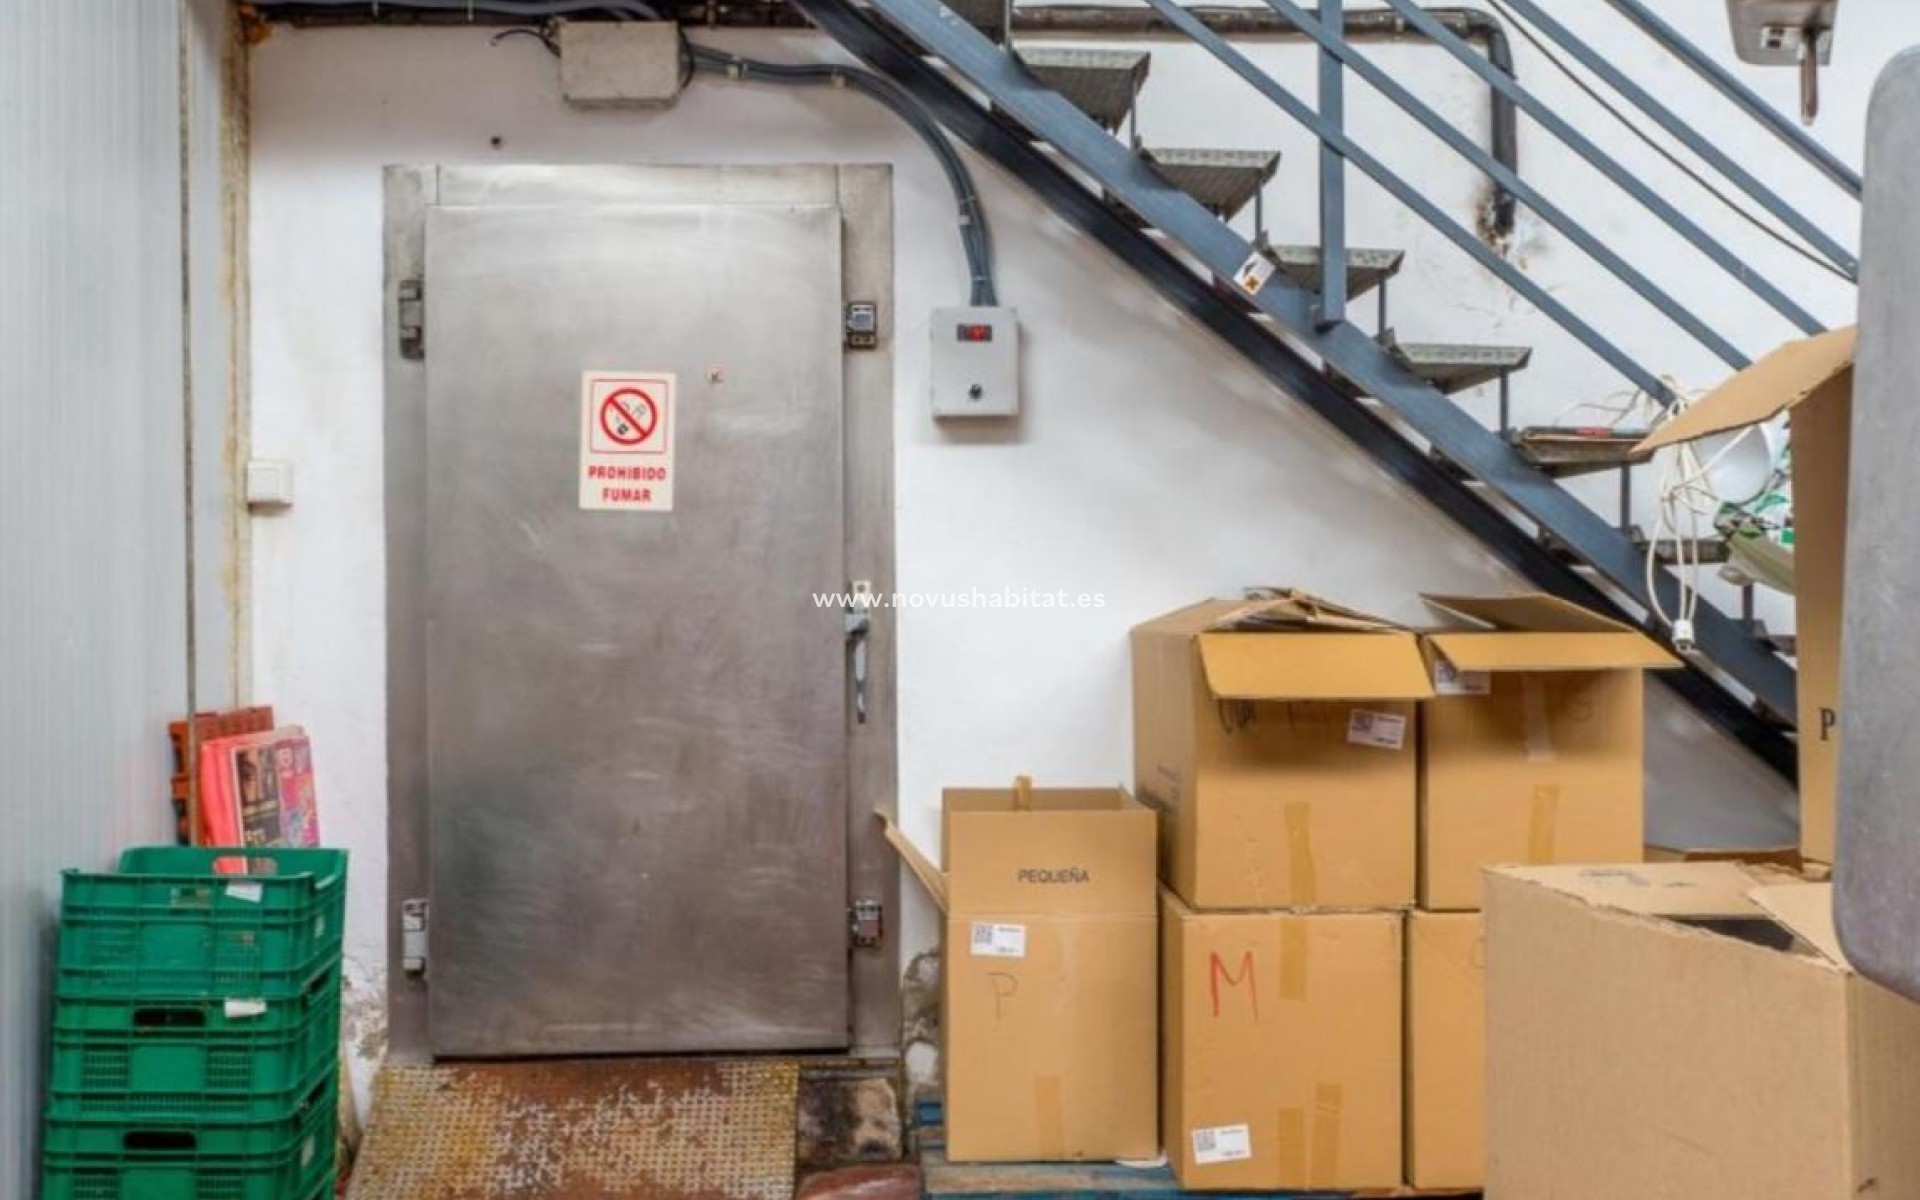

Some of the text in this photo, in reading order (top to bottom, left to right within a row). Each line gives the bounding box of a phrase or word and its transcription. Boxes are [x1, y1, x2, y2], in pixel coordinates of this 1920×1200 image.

[587, 464, 667, 481] PROHIBIDO
[602, 487, 651, 502] FUMAR
[1018, 867, 1089, 884] PEQUEÑA
[1210, 949, 1260, 1024] M
